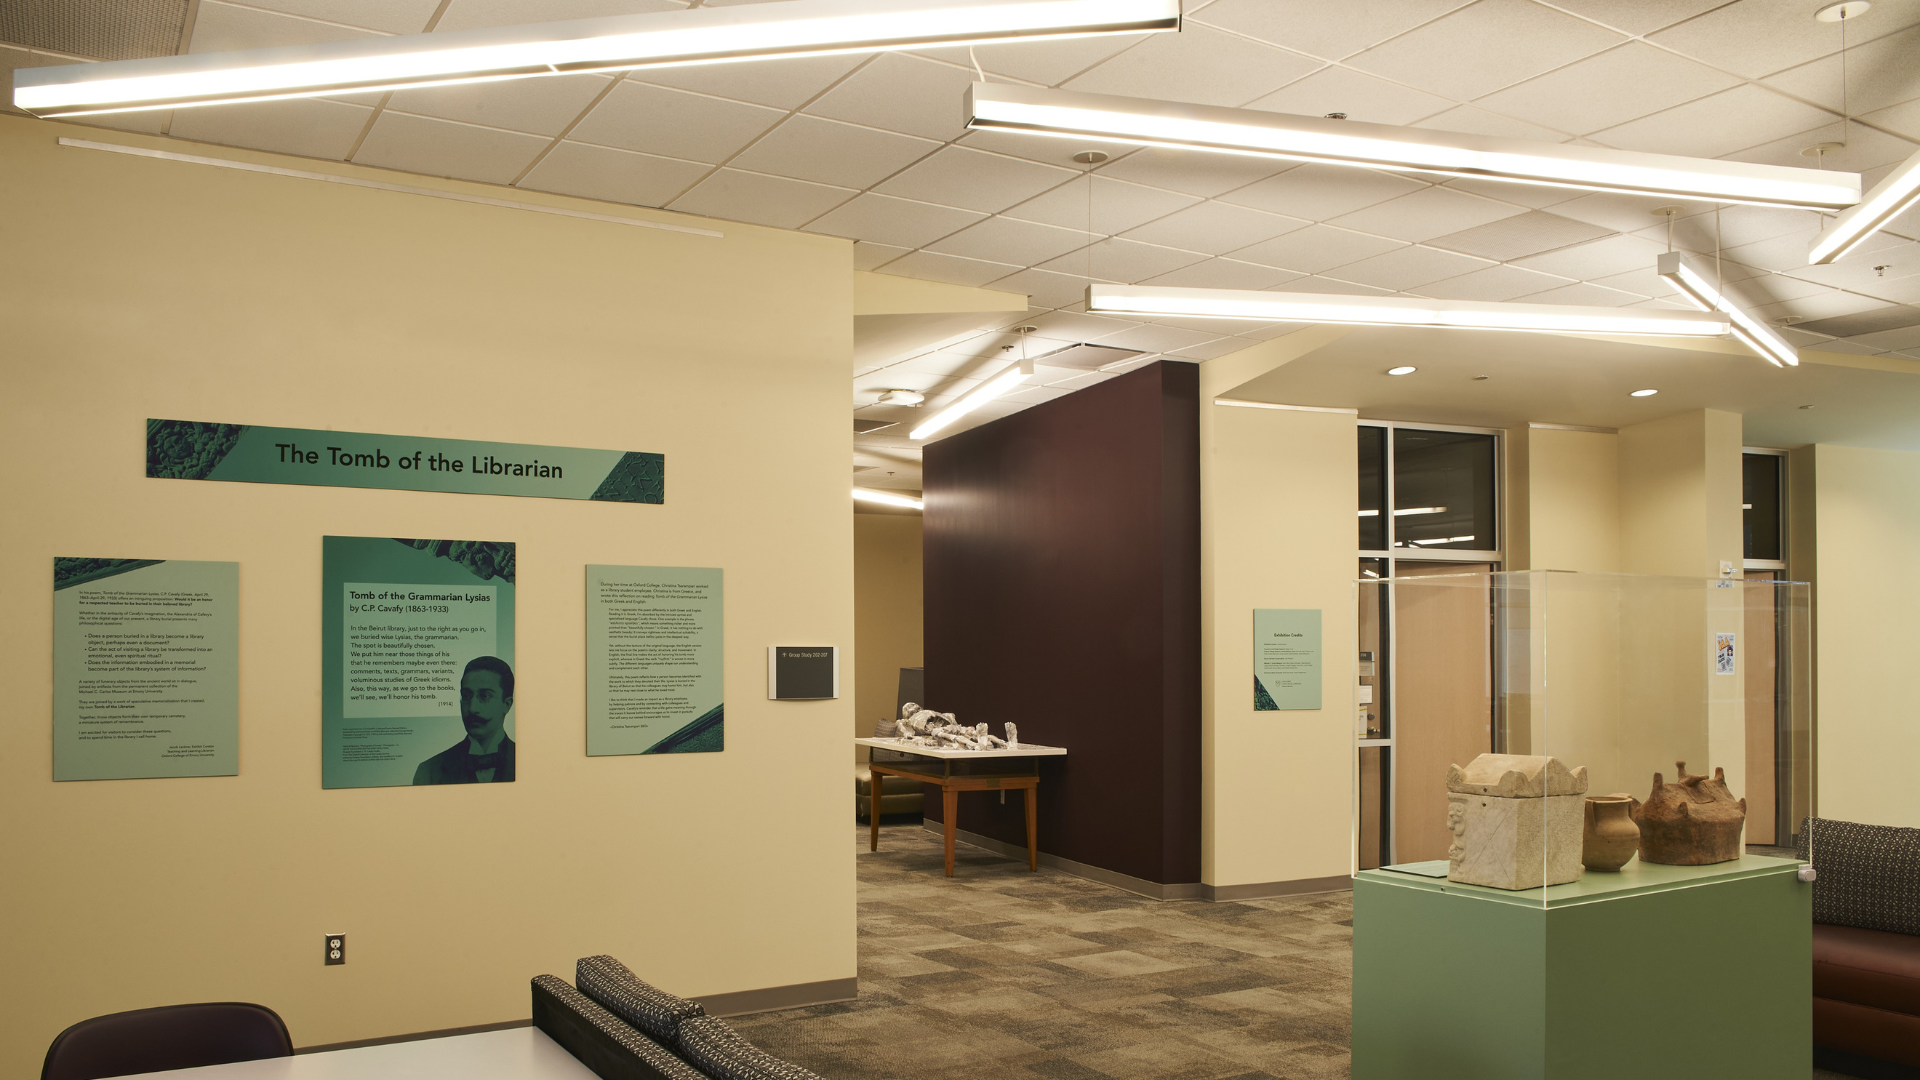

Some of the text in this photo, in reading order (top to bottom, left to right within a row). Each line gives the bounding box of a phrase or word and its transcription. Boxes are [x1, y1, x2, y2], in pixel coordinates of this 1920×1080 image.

[275, 443, 562, 478] The Tomb of the Librarian
[408, 593, 462, 601] Grammarian
[465, 593, 490, 602] Lysias
